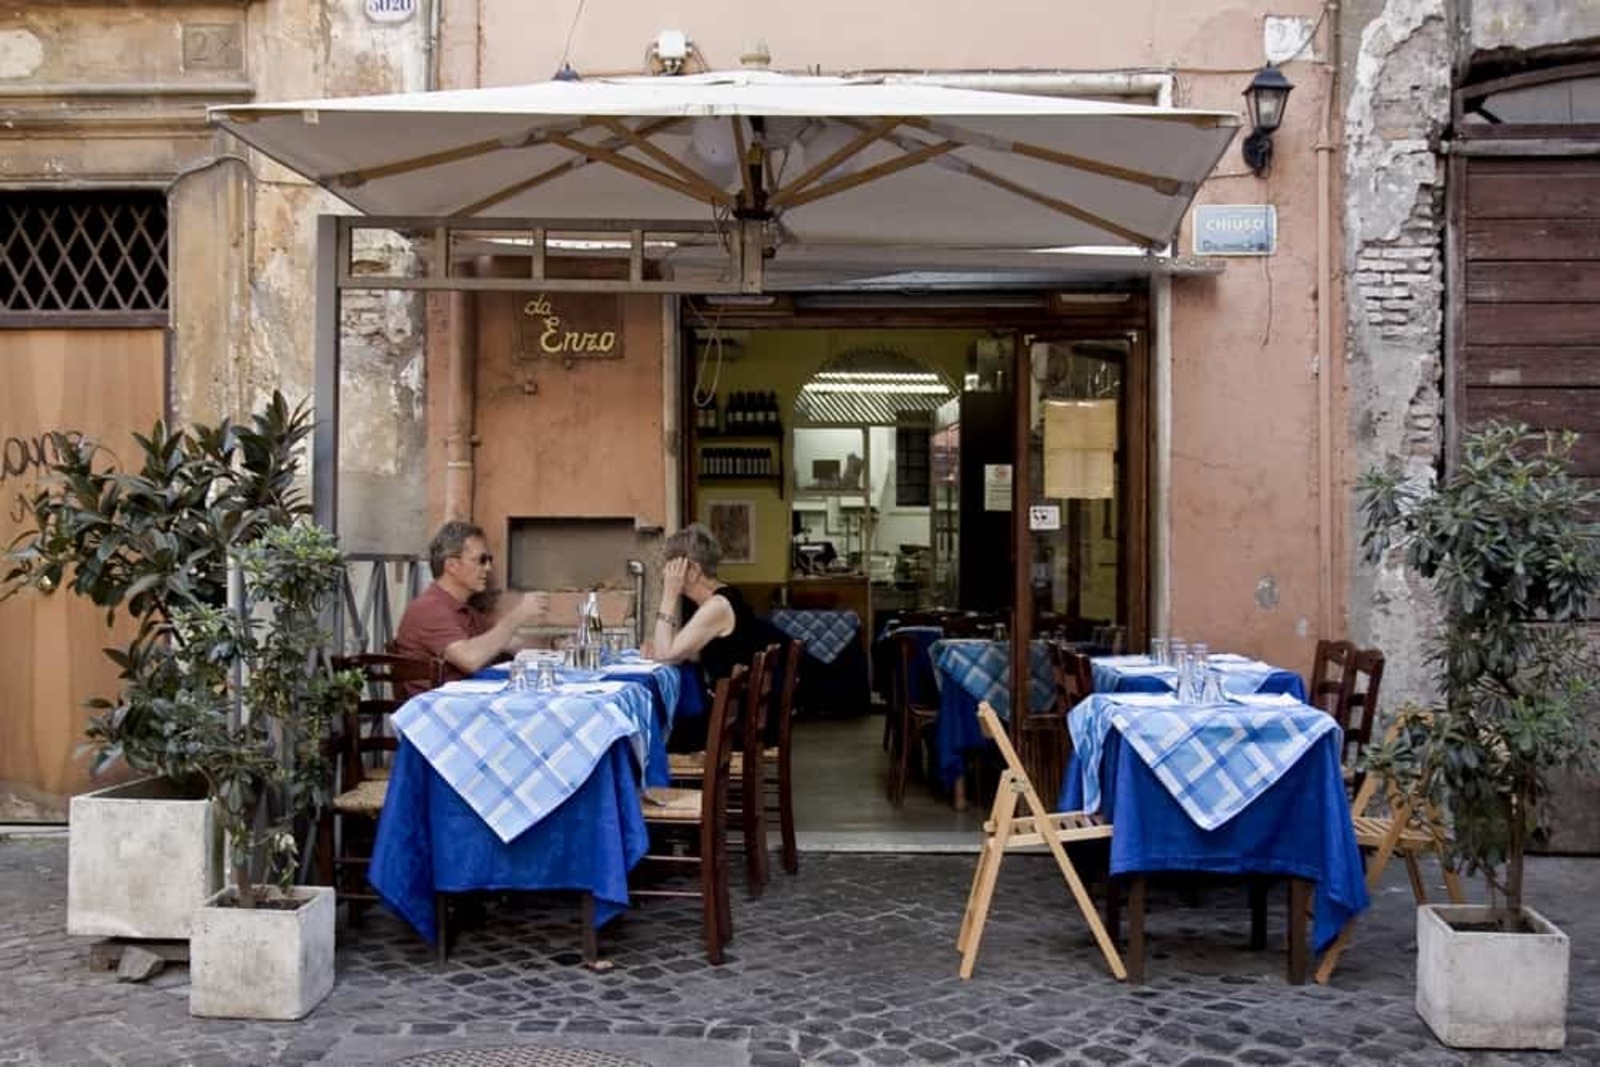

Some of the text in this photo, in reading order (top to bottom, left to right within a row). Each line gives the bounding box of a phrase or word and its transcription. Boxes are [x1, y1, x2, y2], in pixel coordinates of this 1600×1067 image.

[1205, 217, 1263, 231] CHIUSO
[524, 293, 552, 316] da
[540, 316, 616, 353] Enzo
